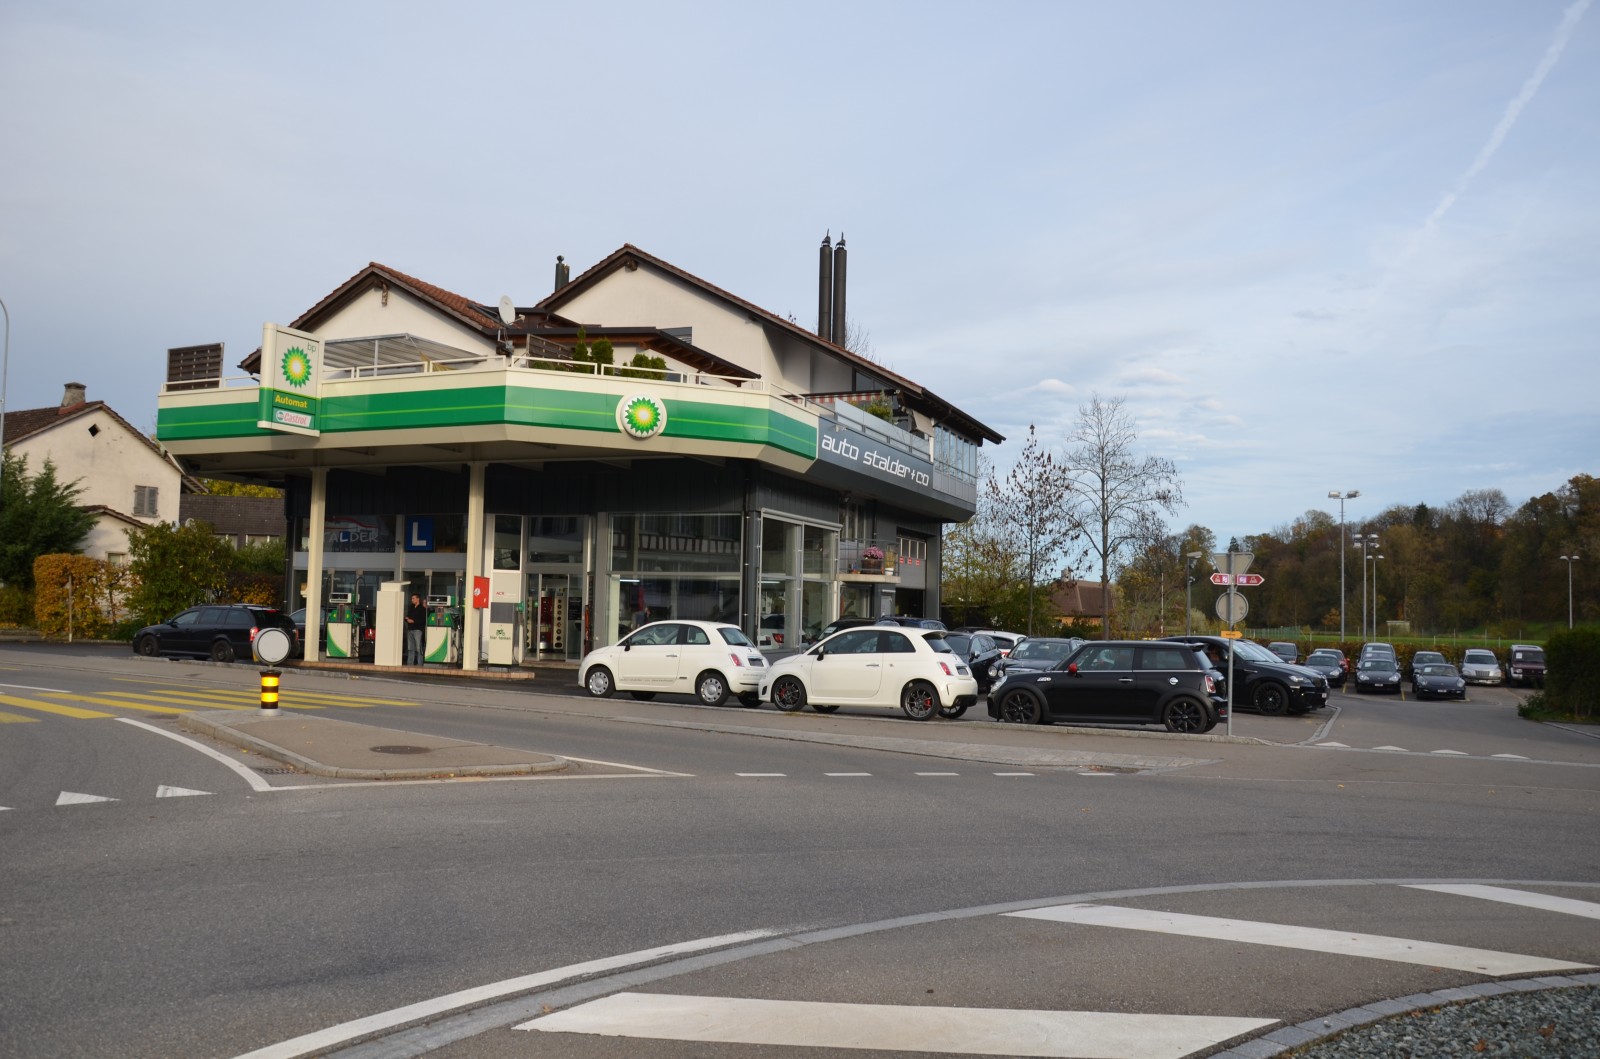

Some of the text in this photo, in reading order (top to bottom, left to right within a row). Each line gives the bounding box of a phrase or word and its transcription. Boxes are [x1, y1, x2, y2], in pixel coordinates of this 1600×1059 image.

[307, 342, 316, 353] bp
[275, 394, 308, 409] Automat
[283, 412, 307, 425] Castrol
[822, 434, 859, 460] auto
[411, 521, 427, 547] L
